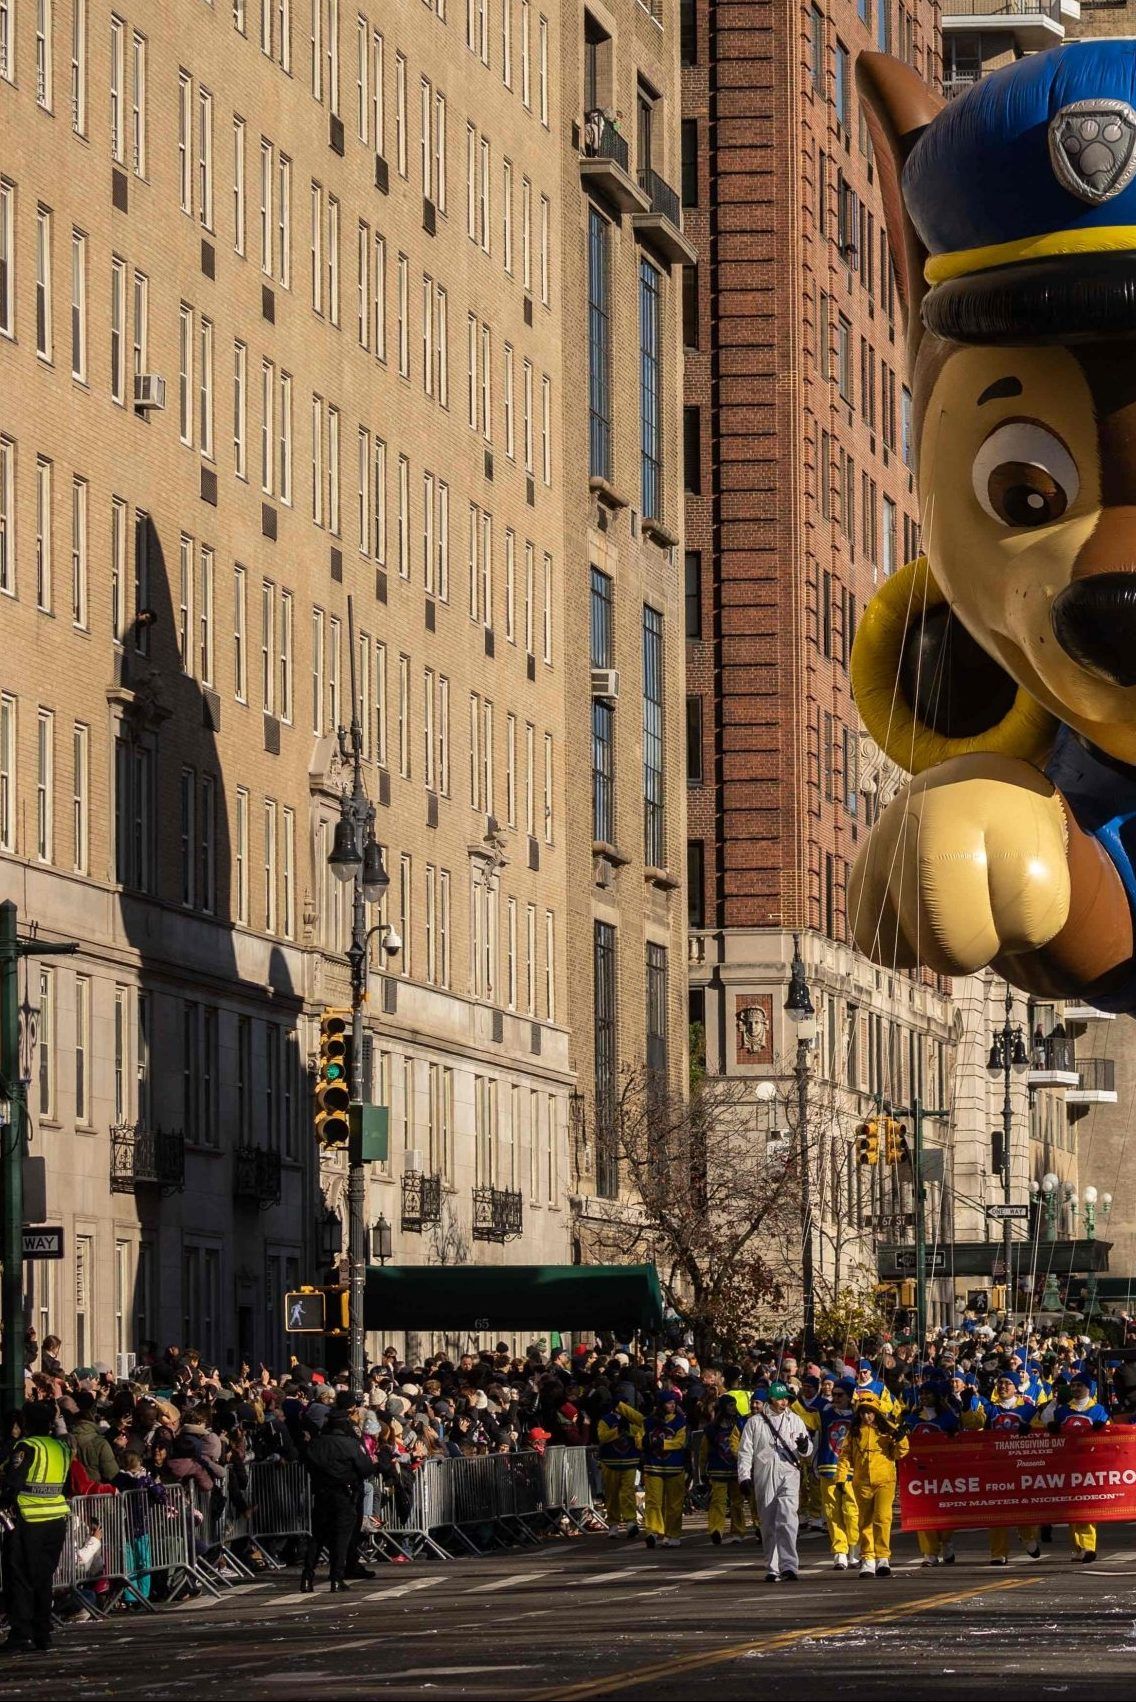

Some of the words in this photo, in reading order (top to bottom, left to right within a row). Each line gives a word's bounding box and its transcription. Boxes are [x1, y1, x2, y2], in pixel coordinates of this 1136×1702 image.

[881, 1216, 892, 1225] 67
[896, 1215, 906, 1225] ST
[24, 1236, 54, 1249] WAY
[474, 1318, 490, 1329] 65
[995, 1439, 1049, 1450] THANKSGIVING
[1051, 1438, 1066, 1448] DAY
[1016, 1459, 1046, 1468] Presents
[908, 1477, 980, 1495] CHASE
[985, 1482, 1015, 1492] FROM
[1021, 1473, 1065, 1490] PAW
[969, 1498, 1019, 1507] MASTER
